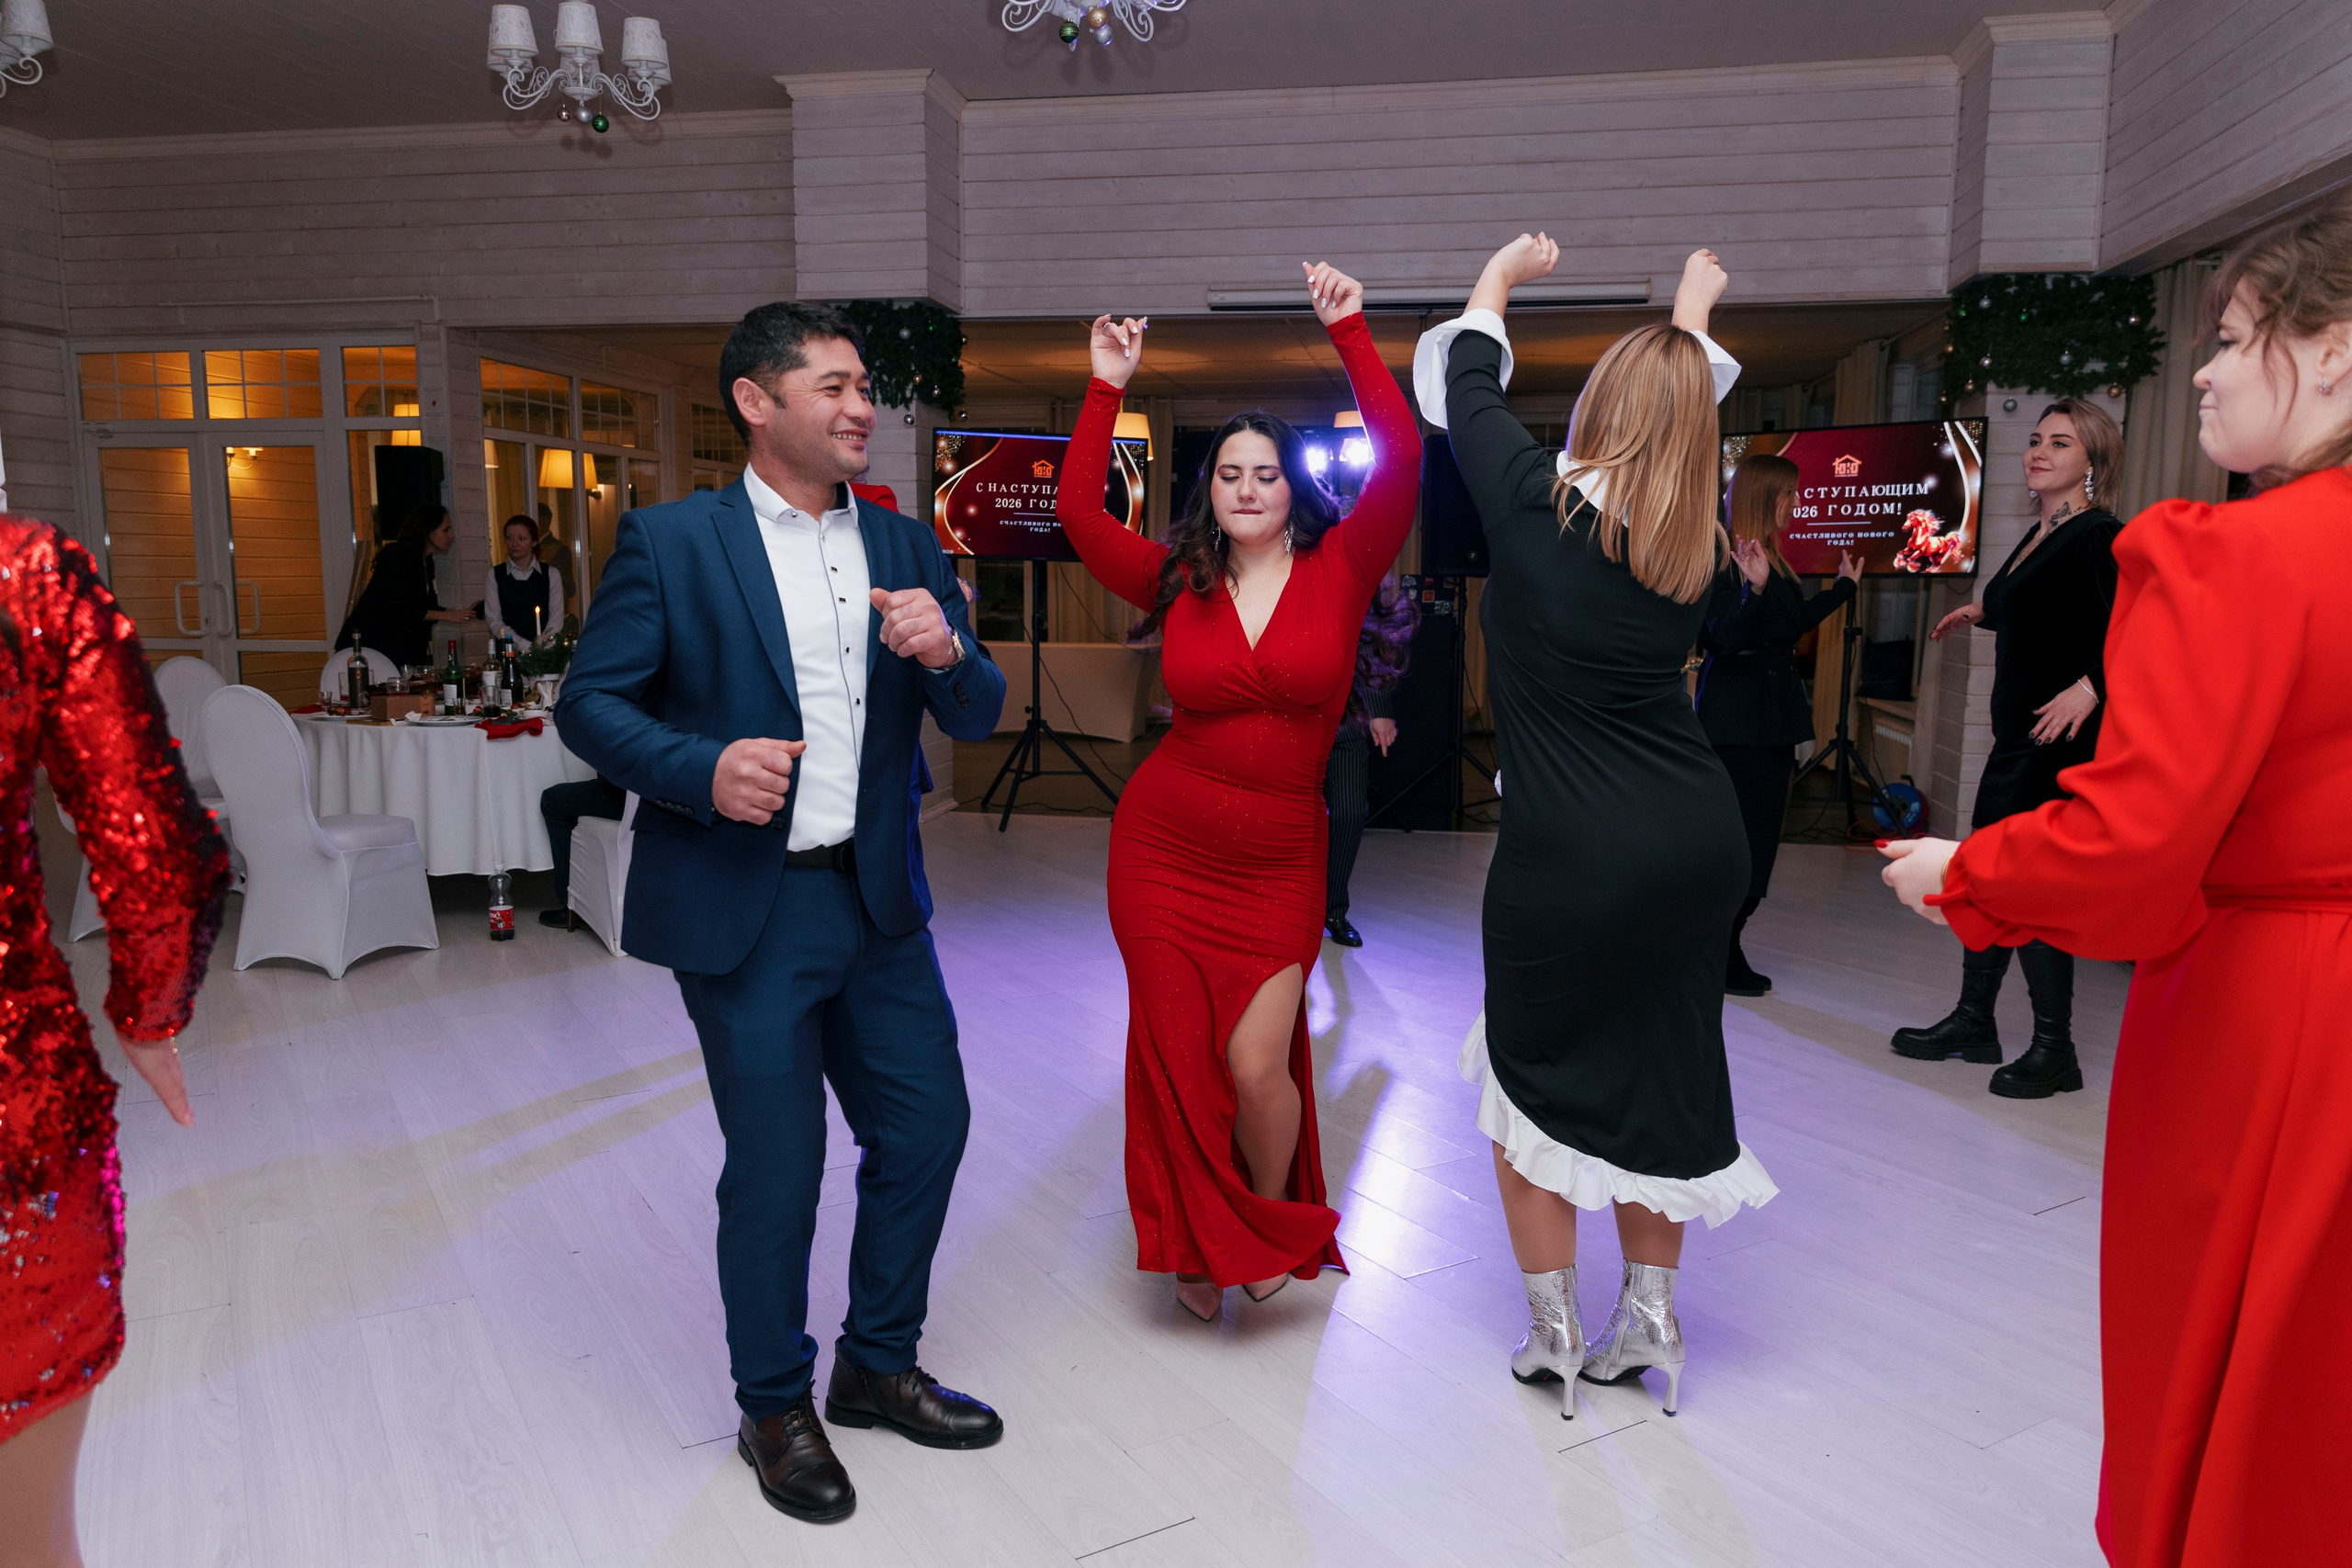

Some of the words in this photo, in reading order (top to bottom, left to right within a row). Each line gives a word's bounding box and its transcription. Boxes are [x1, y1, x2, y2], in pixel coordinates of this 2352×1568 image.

[976, 482, 983, 492] С
[988, 482, 1058, 494] НАСТУПА
[1795, 483, 1929, 499] СТУПАЮЩИМ
[995, 498, 1022, 508] 2026
[1029, 499, 1057, 510] ГОД
[1793, 505, 1818, 518] 026
[1827, 502, 1902, 516] ГОДОМ!
[1789, 531, 1855, 539] СЧАСТЛИВОГО
